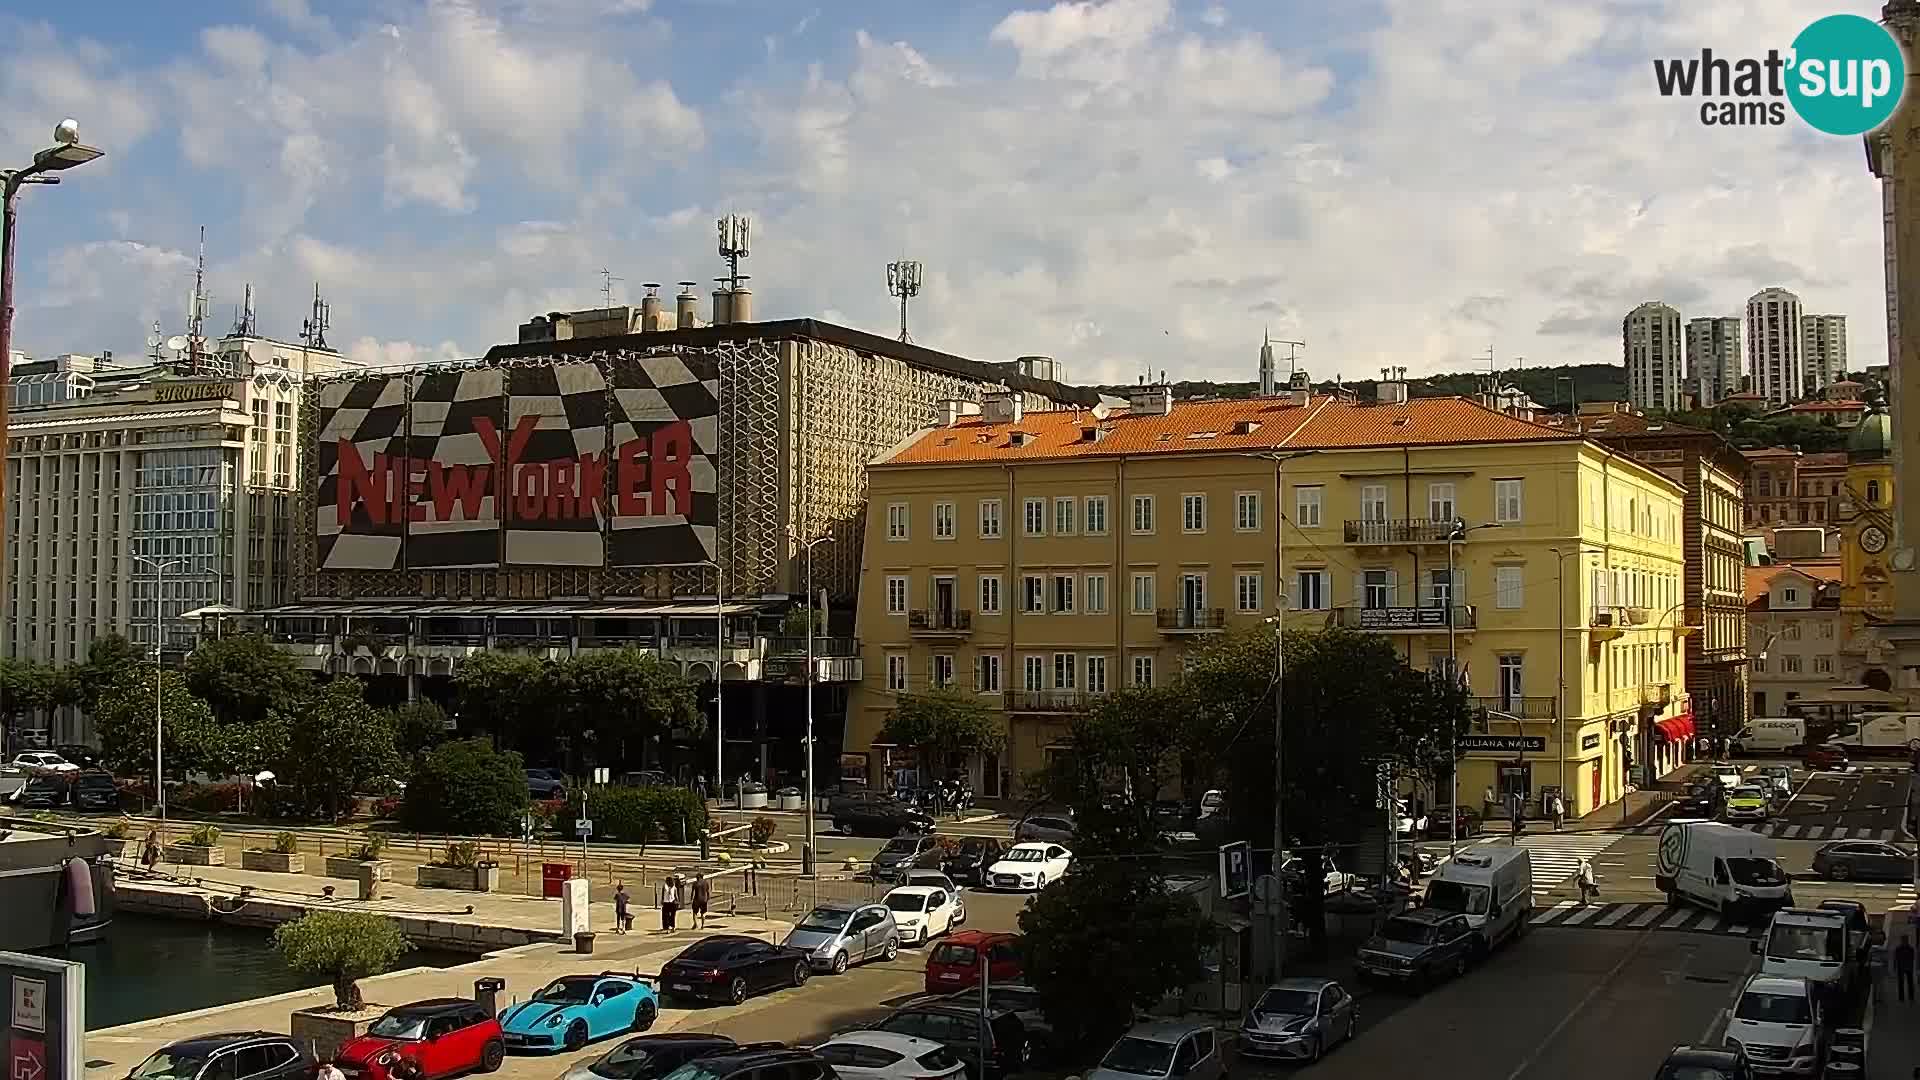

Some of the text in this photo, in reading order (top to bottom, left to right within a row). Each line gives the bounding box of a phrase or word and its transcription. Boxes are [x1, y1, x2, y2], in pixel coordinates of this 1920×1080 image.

[338, 415, 693, 527] NEW YORKER
[1458, 738, 1540, 748] JULIANA NAILS
